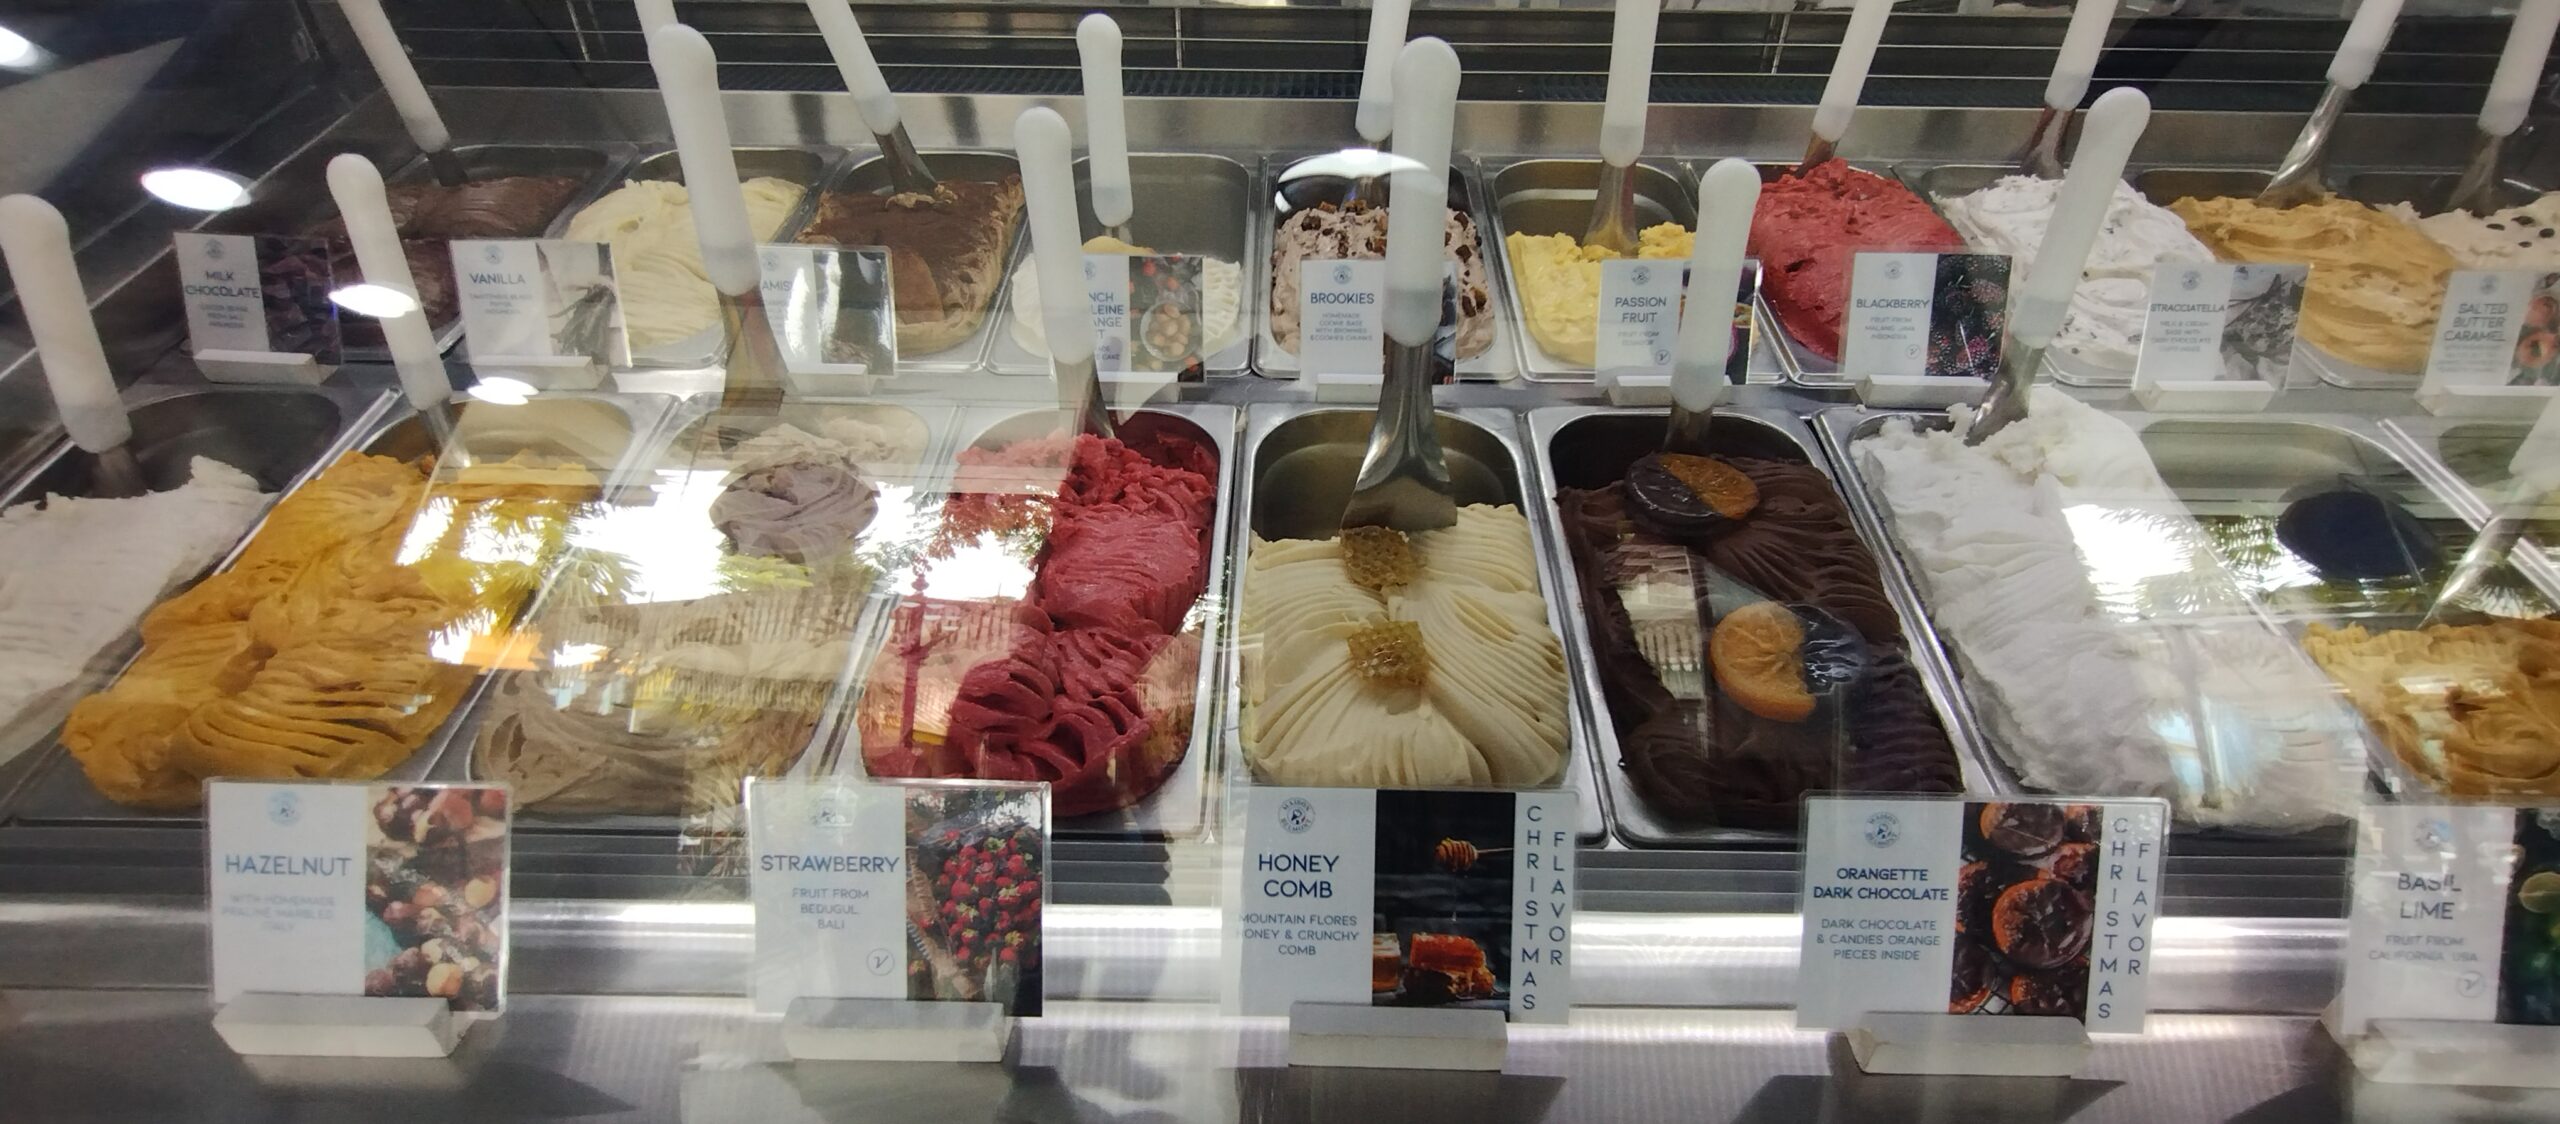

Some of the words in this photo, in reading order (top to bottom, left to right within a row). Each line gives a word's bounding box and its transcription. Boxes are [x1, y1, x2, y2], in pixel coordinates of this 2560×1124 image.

[206, 271, 234, 281] MILK
[469, 273, 526, 285] VANILLA
[185, 285, 260, 298] CHOCOLATE
[1310, 293, 1375, 304] BROOKIES
[1615, 297, 1667, 307] PASSION
[1856, 299, 1930, 309] BLACKBERRY
[2151, 304, 2225, 312] STRACCIATELLA
[2458, 303, 2508, 314] SALTED
[1622, 312, 1658, 323] FRUIT
[2453, 316, 2506, 328] BUTTER
[2444, 330, 2506, 341] CARAMEL
[225, 854, 352, 876] HAZELNUT
[761, 854, 900, 873] STRAWBERRY
[1258, 853, 1340, 873] HONEY
[1836, 868, 1929, 881] ORANGETTE
[792, 888, 829, 898] FRUIT
[833, 888, 869, 899] FROM
[1264, 879, 1333, 898] COMB
[1813, 886, 1853, 899] DARK
[1858, 887, 1950, 900] CHOCOLATE
[1548, 832, 1566, 966] FLAVOR
[1521, 805, 1542, 1010] CHRISTMAS
[2128, 843, 2151, 975] FLAVOR
[2400, 902, 2455, 920] LIME
[1239, 912, 1305, 925] MOUNTAIN
[1310, 914, 1358, 926] FLORES
[2098, 817, 2129, 1019] CHRISTMAS
[817, 919, 845, 930] BALI
[1821, 918, 1854, 930] DARK
[1858, 919, 1937, 931] CHOCOLATE
[1237, 928, 1280, 940] ONEY
[1284, 929, 1293, 940] &
[1298, 929, 1360, 942] CRUNCHY
[1816, 934, 1825, 944] &
[1830, 934, 1884, 945] CANDIES
[1888, 935, 1941, 946] ORANGE
[2386, 935, 2422, 946] FRUIT
[2426, 935, 2464, 946] FROM
[1278, 944, 1316, 956] COMB
[1834, 949, 1877, 960] PIECES
[1881, 950, 1920, 960] INSIDE
[2452, 951, 2479, 962] USA
